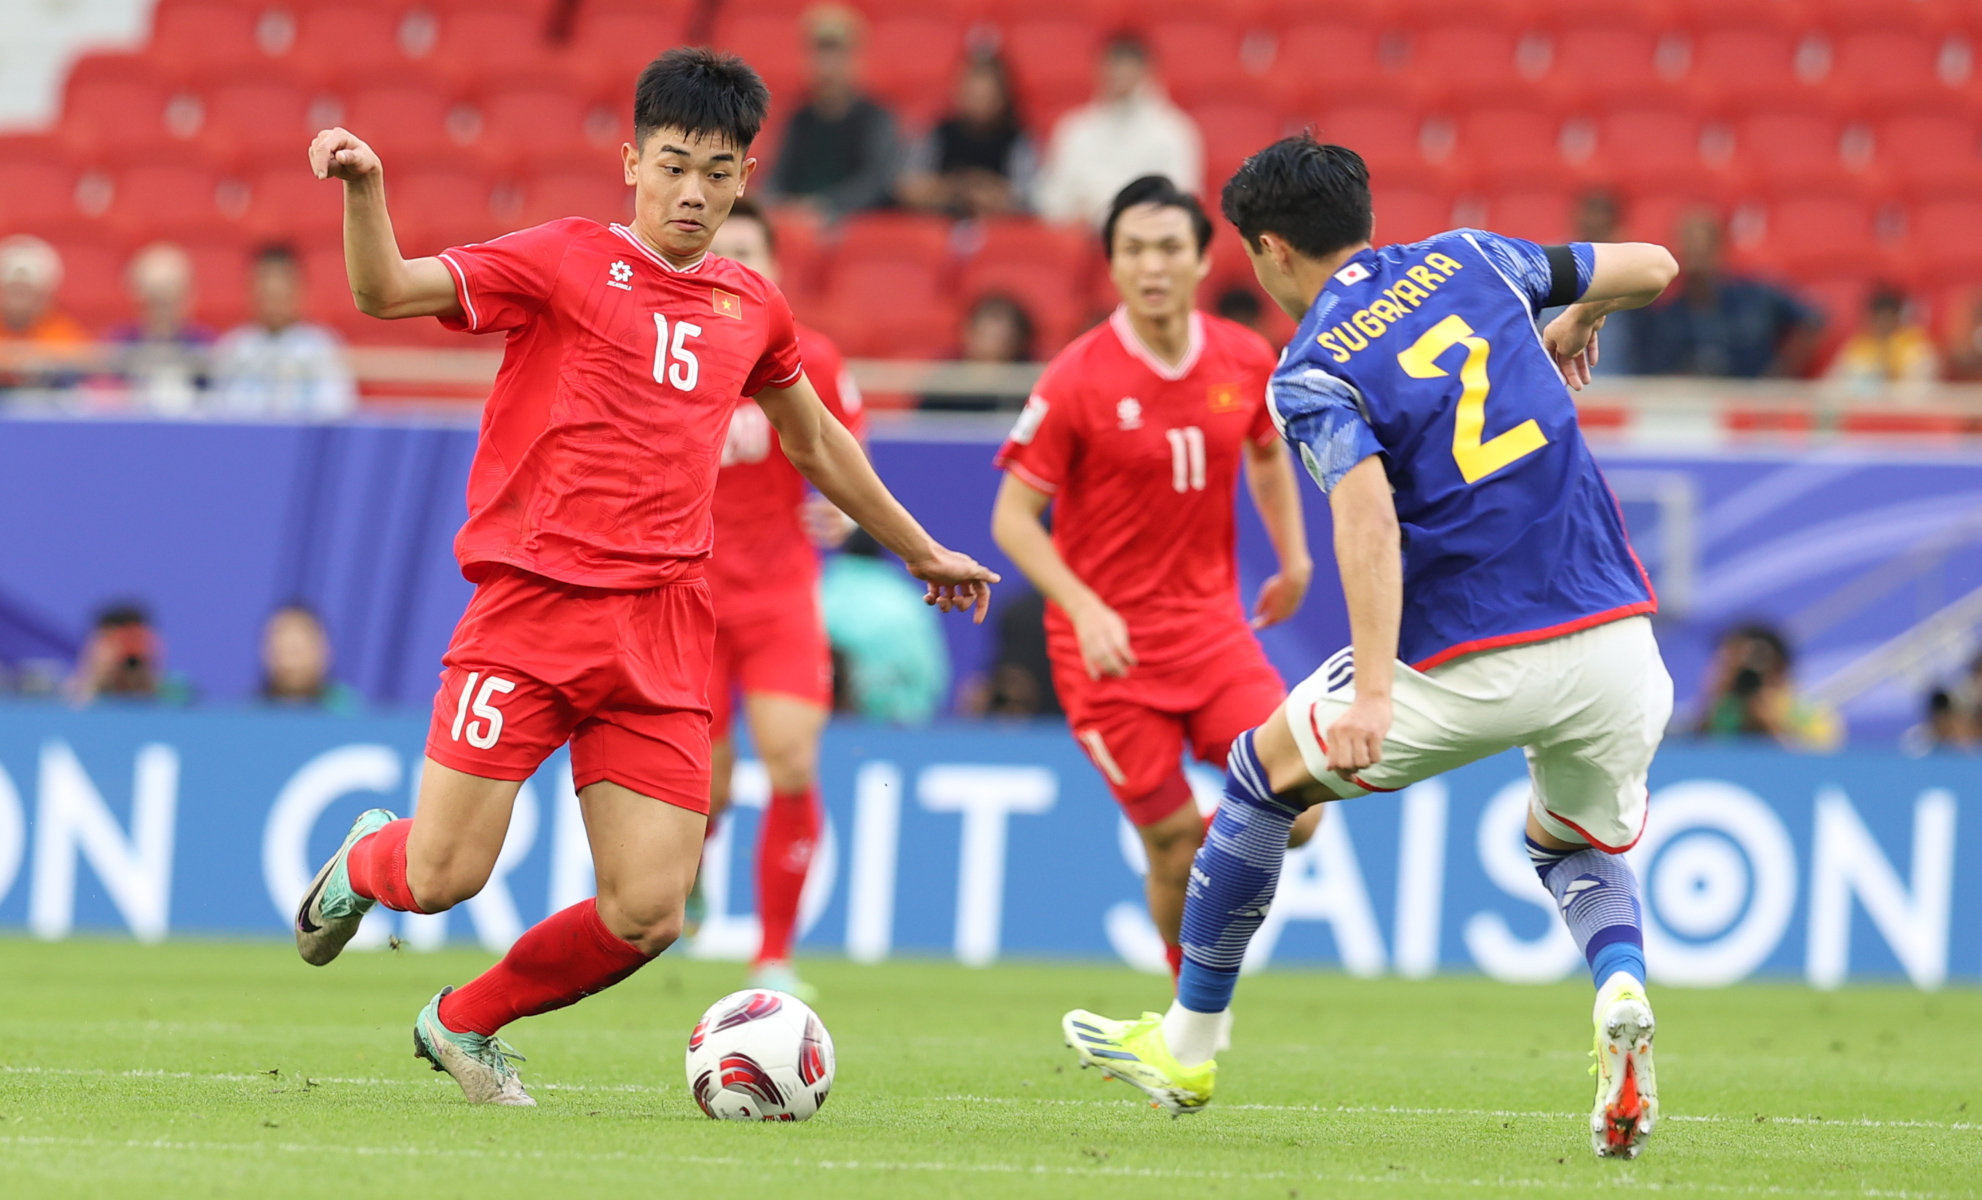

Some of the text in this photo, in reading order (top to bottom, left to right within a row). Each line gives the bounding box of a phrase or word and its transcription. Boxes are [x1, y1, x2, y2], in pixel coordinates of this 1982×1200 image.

[652, 312, 702, 392] 15
[1397, 314, 1549, 485] 2
[1166, 426, 1207, 494] 11
[451, 672, 516, 750] 15
[0, 736, 182, 946] N
[262, 744, 1058, 966] CRDIT
